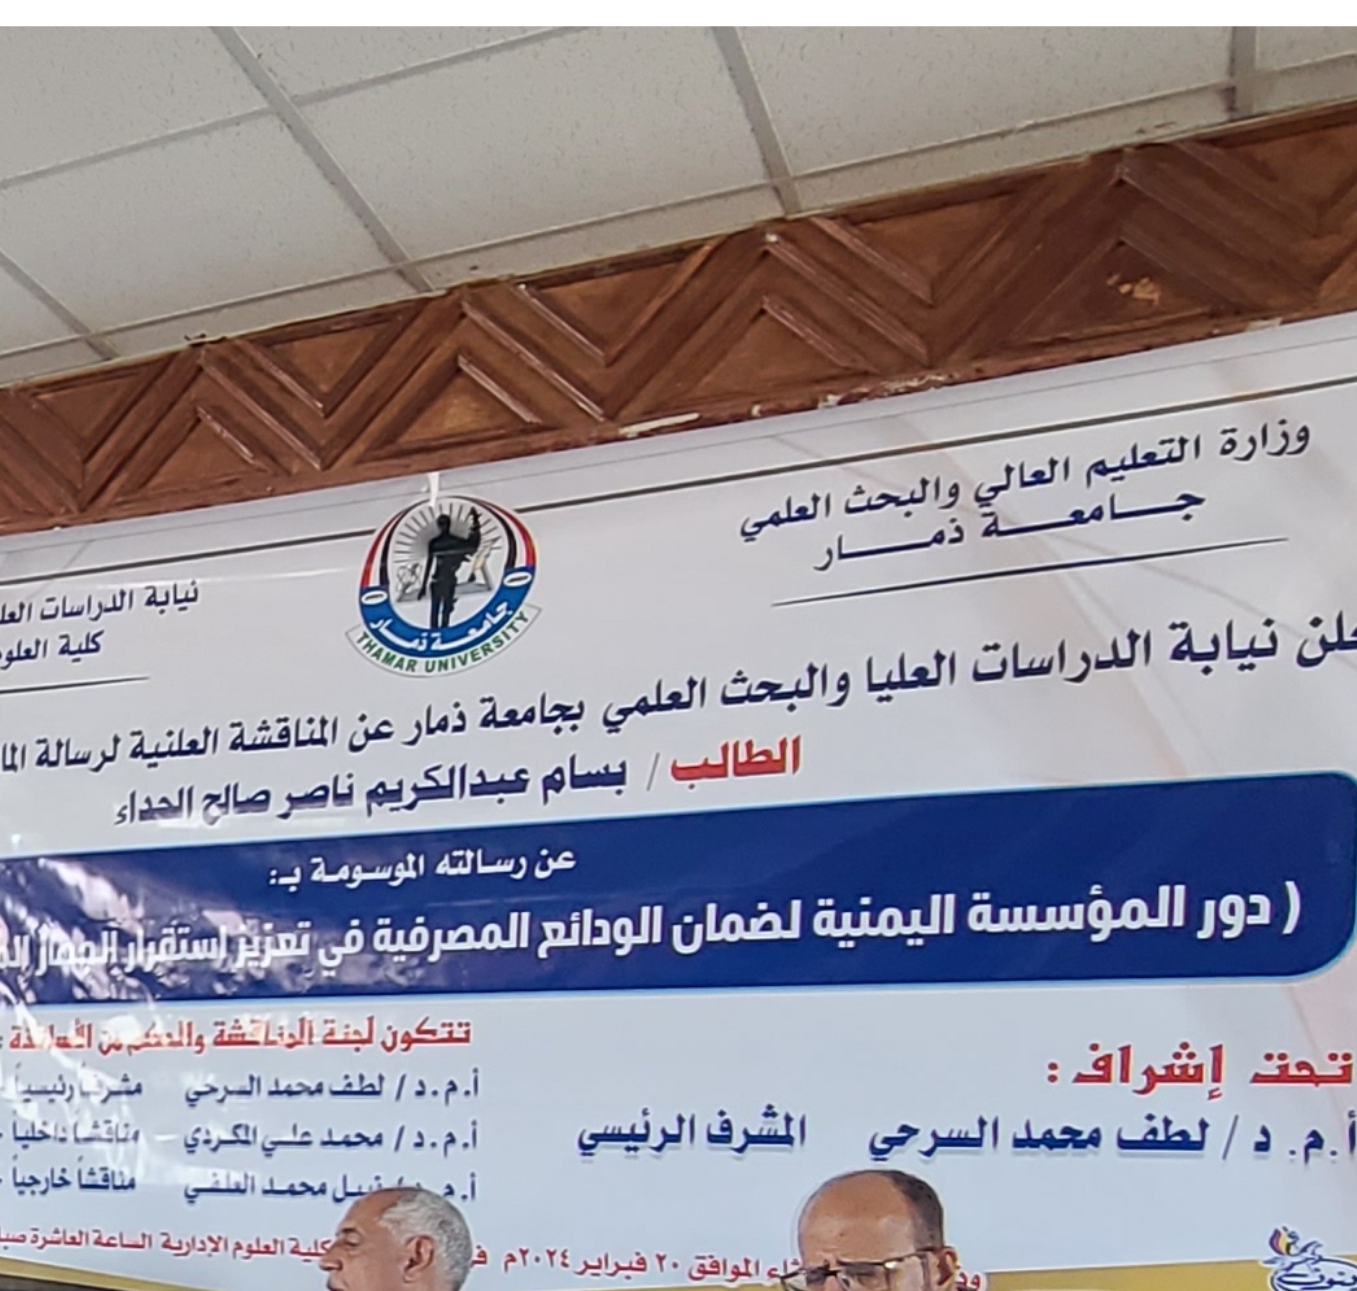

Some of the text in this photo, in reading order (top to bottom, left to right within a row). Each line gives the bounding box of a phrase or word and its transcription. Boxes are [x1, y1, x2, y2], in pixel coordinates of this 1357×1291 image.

[739, 422, 1310, 542] وزارة التعليم العالي والبحث العلمي
[41, 586, 131, 623] الدراسات
[145, 579, 198, 612] نيابة
[59, 630, 103, 659] كلية
[356, 611, 529, 673] THAMAR UNIVERSITY
[970, 630, 1150, 689] الدراسات
[1168, 617, 1279, 675] نيابة
[719, 659, 849, 710] والبحث
[866, 647, 956, 705] العليا
[411, 697, 465, 752] ذمار
[478, 690, 585, 735] بجامعة
[600, 679, 706, 734] العلمي
[35, 729, 121, 772] لرسالة
[129, 725, 218, 765] العلنية
[228, 714, 338, 755] المناقشة
[348, 714, 395, 755] عن
[540, 753, 627, 803] بسام
[670, 735, 800, 788] الطالب
[113, 788, 193, 827] الحداء
[204, 785, 271, 828] صالح
[279, 774, 354, 820] ناصر
[311, 853, 425, 892] الموسومة
[434, 848, 526, 888] رسالته
[532, 850, 575, 878] عن
[535, 906, 661, 959] الودائع
[671, 900, 800, 956] لضمان
[812, 893, 953, 949] اليمنية
[966, 883, 1184, 943] المؤسسة
[1196, 890, 1271, 941] دور
[125, 926, 227, 973] استقرار
[236, 921, 311, 969] تعزيز
[318, 920, 365, 973] في
[371, 910, 530, 965] المصرفية
[322, 1016, 374, 1052] لجنة
[380, 1017, 471, 1052] تتكون
[185, 1075, 261, 1107] السرحي
[268, 1078, 323, 1097] محمد
[329, 1072, 384, 1097] لطف
[1073, 1042, 1352, 1102] تحت إشراف
[184, 1123, 257, 1154] الكردي
[262, 1123, 313, 1157] علي
[320, 1127, 383, 1148] محمد
[577, 1102, 1210, 1162] لطف محمد السرحي المشرف الرئيسي
[262, 1177, 327, 1198] محمد
[30, 1227, 88, 1249] العاشرة
[93, 1228, 152, 1249] الساعة
[162, 1232, 227, 1257] الإدارية
[233, 1238, 284, 1259] العلوم
[575, 1250, 646, 1278] فبراير
[688, 1259, 760, 1290] الموافق
